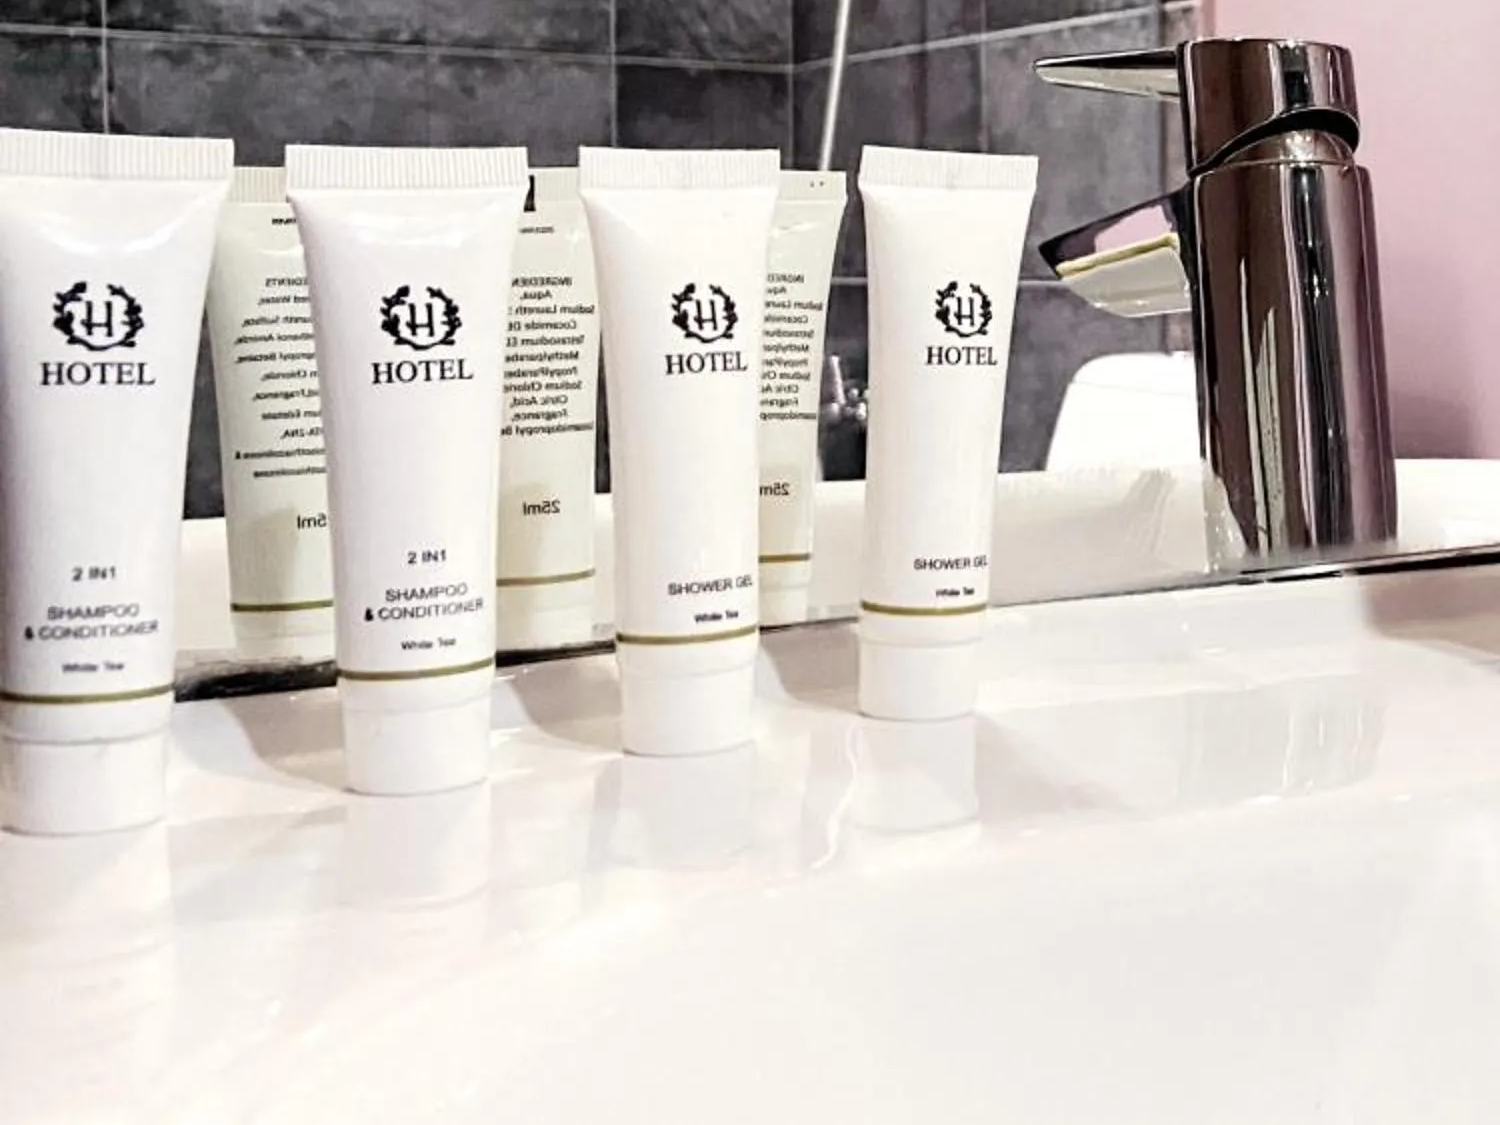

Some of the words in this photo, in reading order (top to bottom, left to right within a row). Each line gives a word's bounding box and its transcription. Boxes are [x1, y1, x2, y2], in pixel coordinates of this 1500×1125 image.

[665, 350, 748, 375] HOTEL
[926, 345, 998, 367] HOTEL
[39, 361, 156, 387] HOTEL
[371, 358, 474, 385] HOTEL
[408, 551, 417, 565] 2
[913, 557, 971, 571] SHOWER
[72, 567, 83, 582] 2
[385, 582, 468, 603] SHAMPOO
[668, 577, 733, 596] SHOWER
[47, 603, 140, 620] SHAMPOO
[364, 607, 375, 622] &
[378, 597, 484, 620] CONDITIONER
[38, 620, 159, 641] CONDITIONER
[401, 640, 433, 650] White
